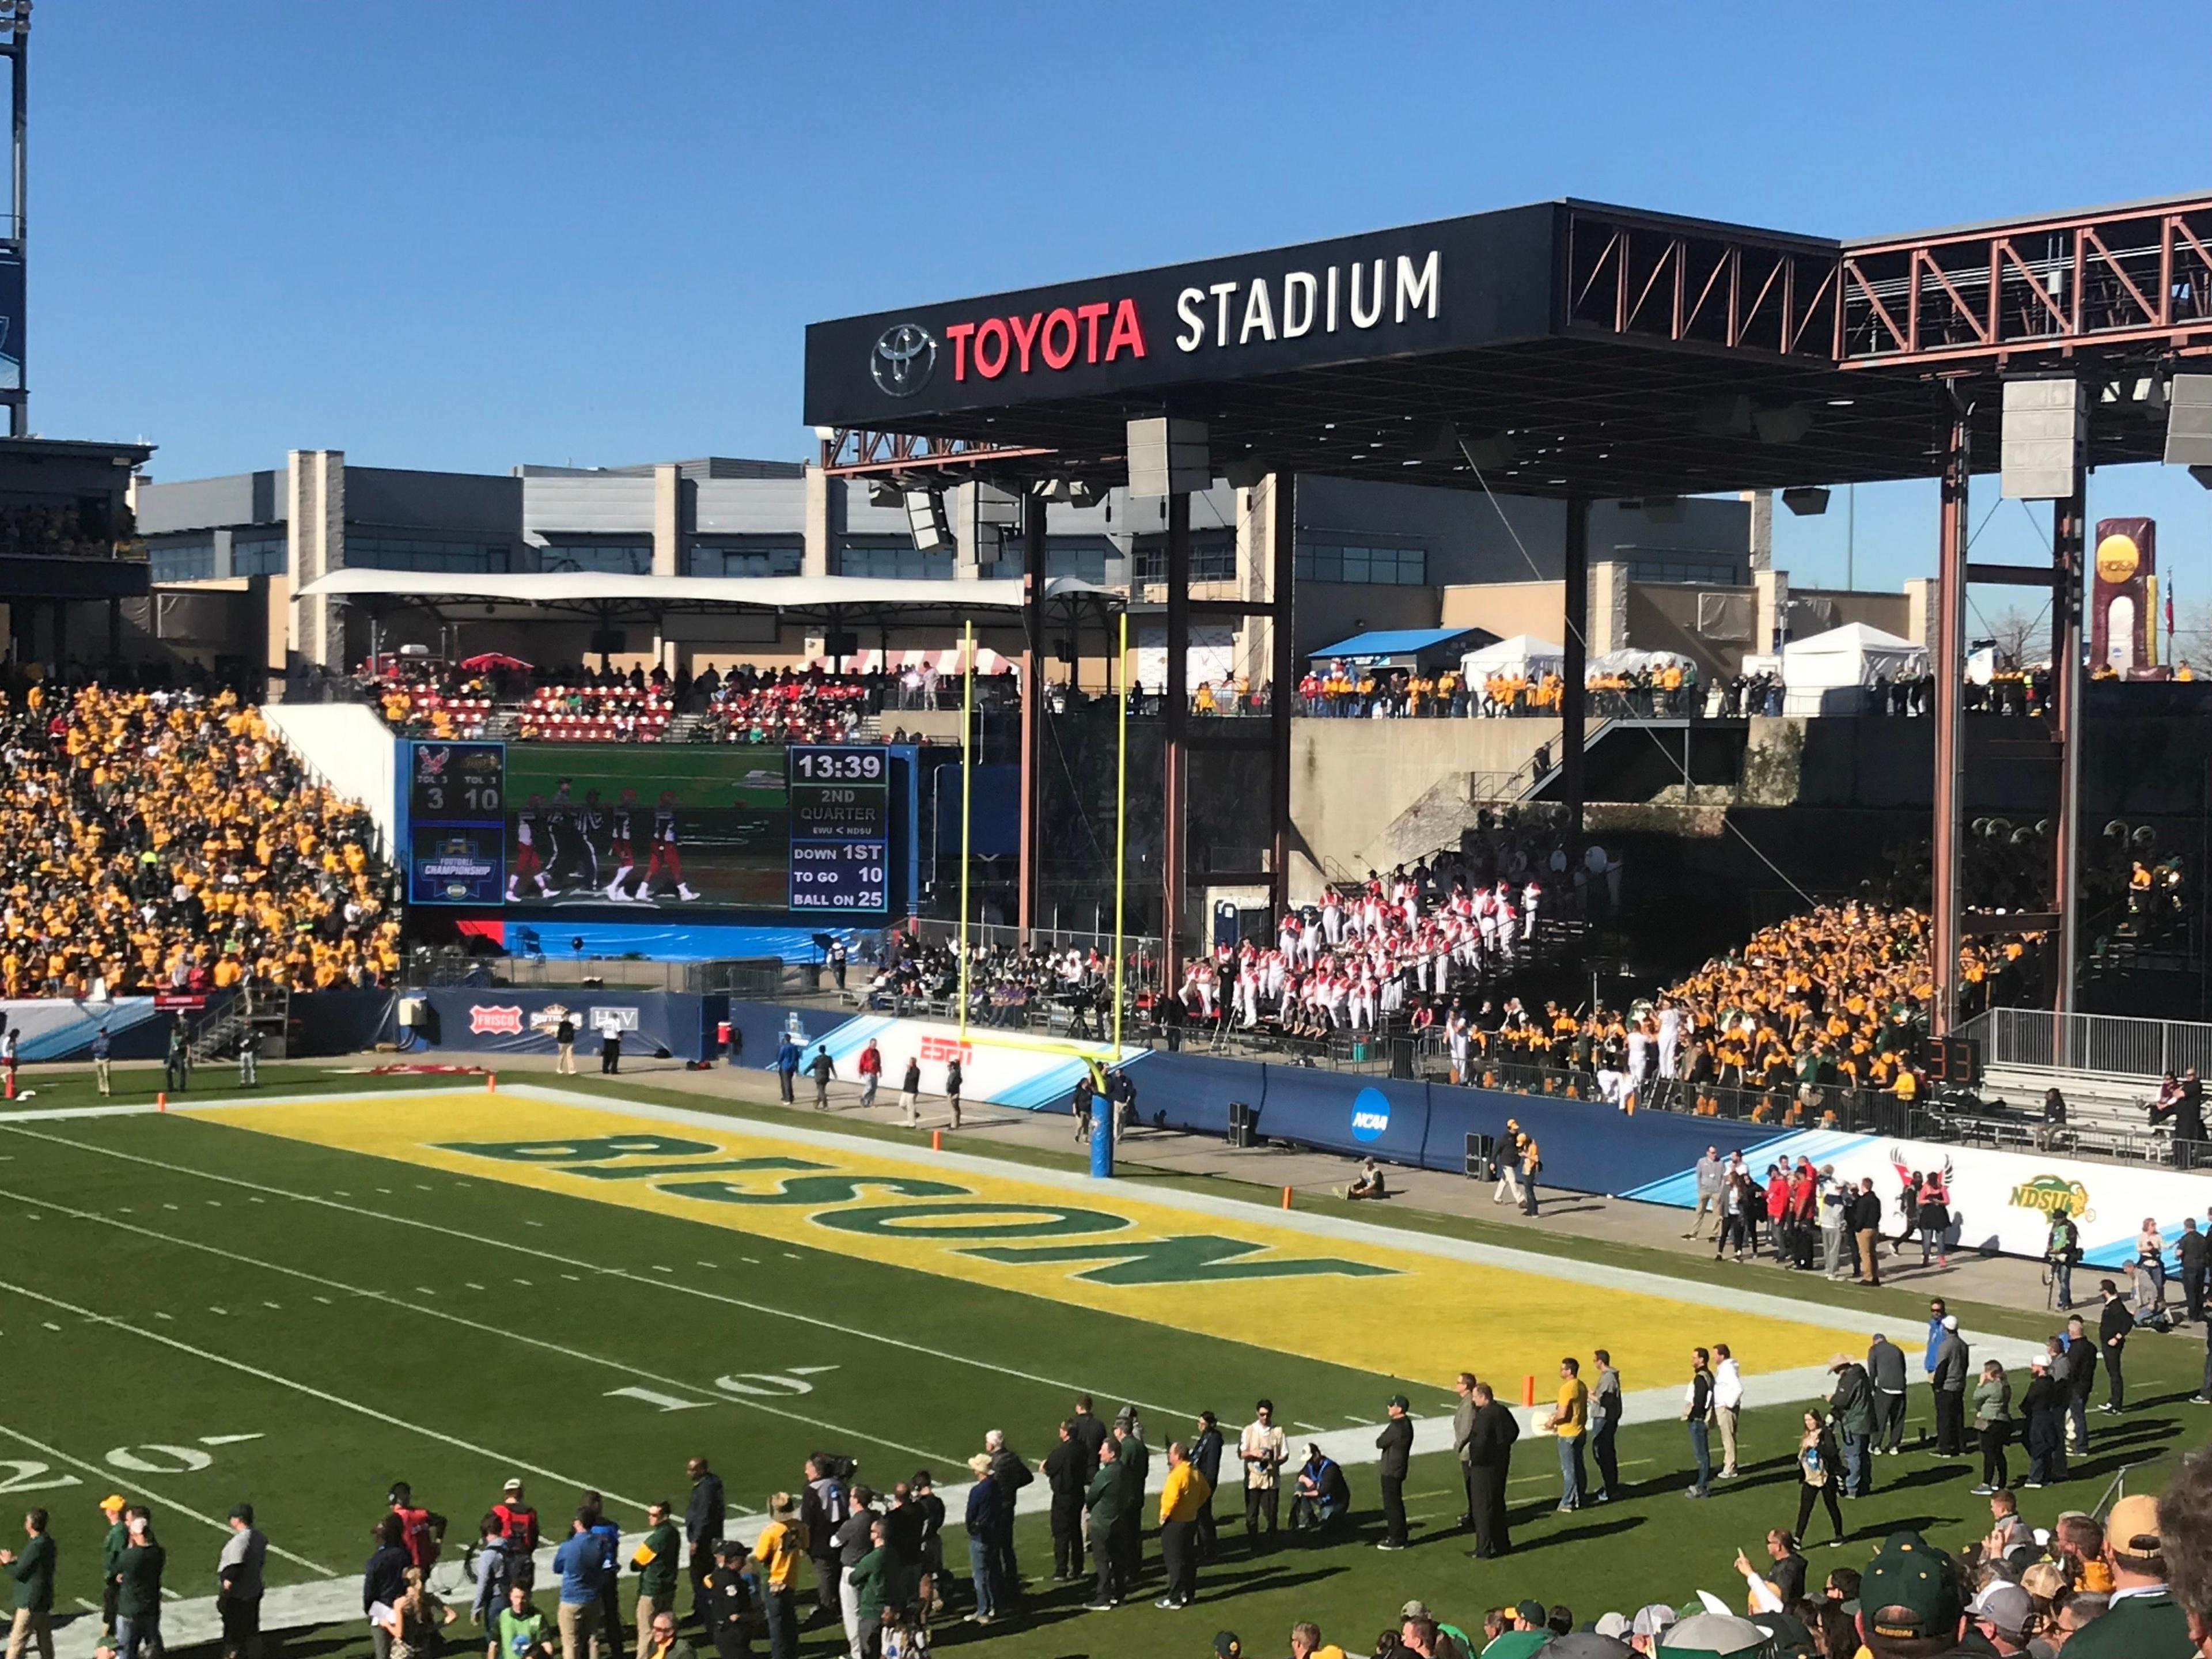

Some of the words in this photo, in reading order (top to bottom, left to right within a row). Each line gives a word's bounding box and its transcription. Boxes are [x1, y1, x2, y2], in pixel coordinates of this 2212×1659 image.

[946, 298, 1146, 381] TOYOTA
[1175, 250, 1442, 353] STADIUM
[798, 755, 880, 778] 13:39
[427, 787, 444, 809] 3
[464, 789, 498, 811] 10
[821, 790, 855, 803] 2ND
[801, 808, 876, 821] QUARTER
[794, 849, 836, 859] DOWN
[843, 844, 882, 860] 1ST
[425, 865, 491, 875] CHAMPIONSHIP
[794, 872, 813, 882] TO
[817, 872, 838, 882] GO
[858, 867, 882, 882] 10
[794, 895, 829, 906] BALL
[834, 895, 854, 906] ON
[858, 892, 882, 906] 25
[478, 1014, 515, 1026] FRISCO
[921, 1036, 972, 1066] ESPN
[1352, 1112, 1388, 1131] NCAA
[2008, 1186, 2068, 1211] NDSU
[423, 1132, 1411, 1286] BISON
